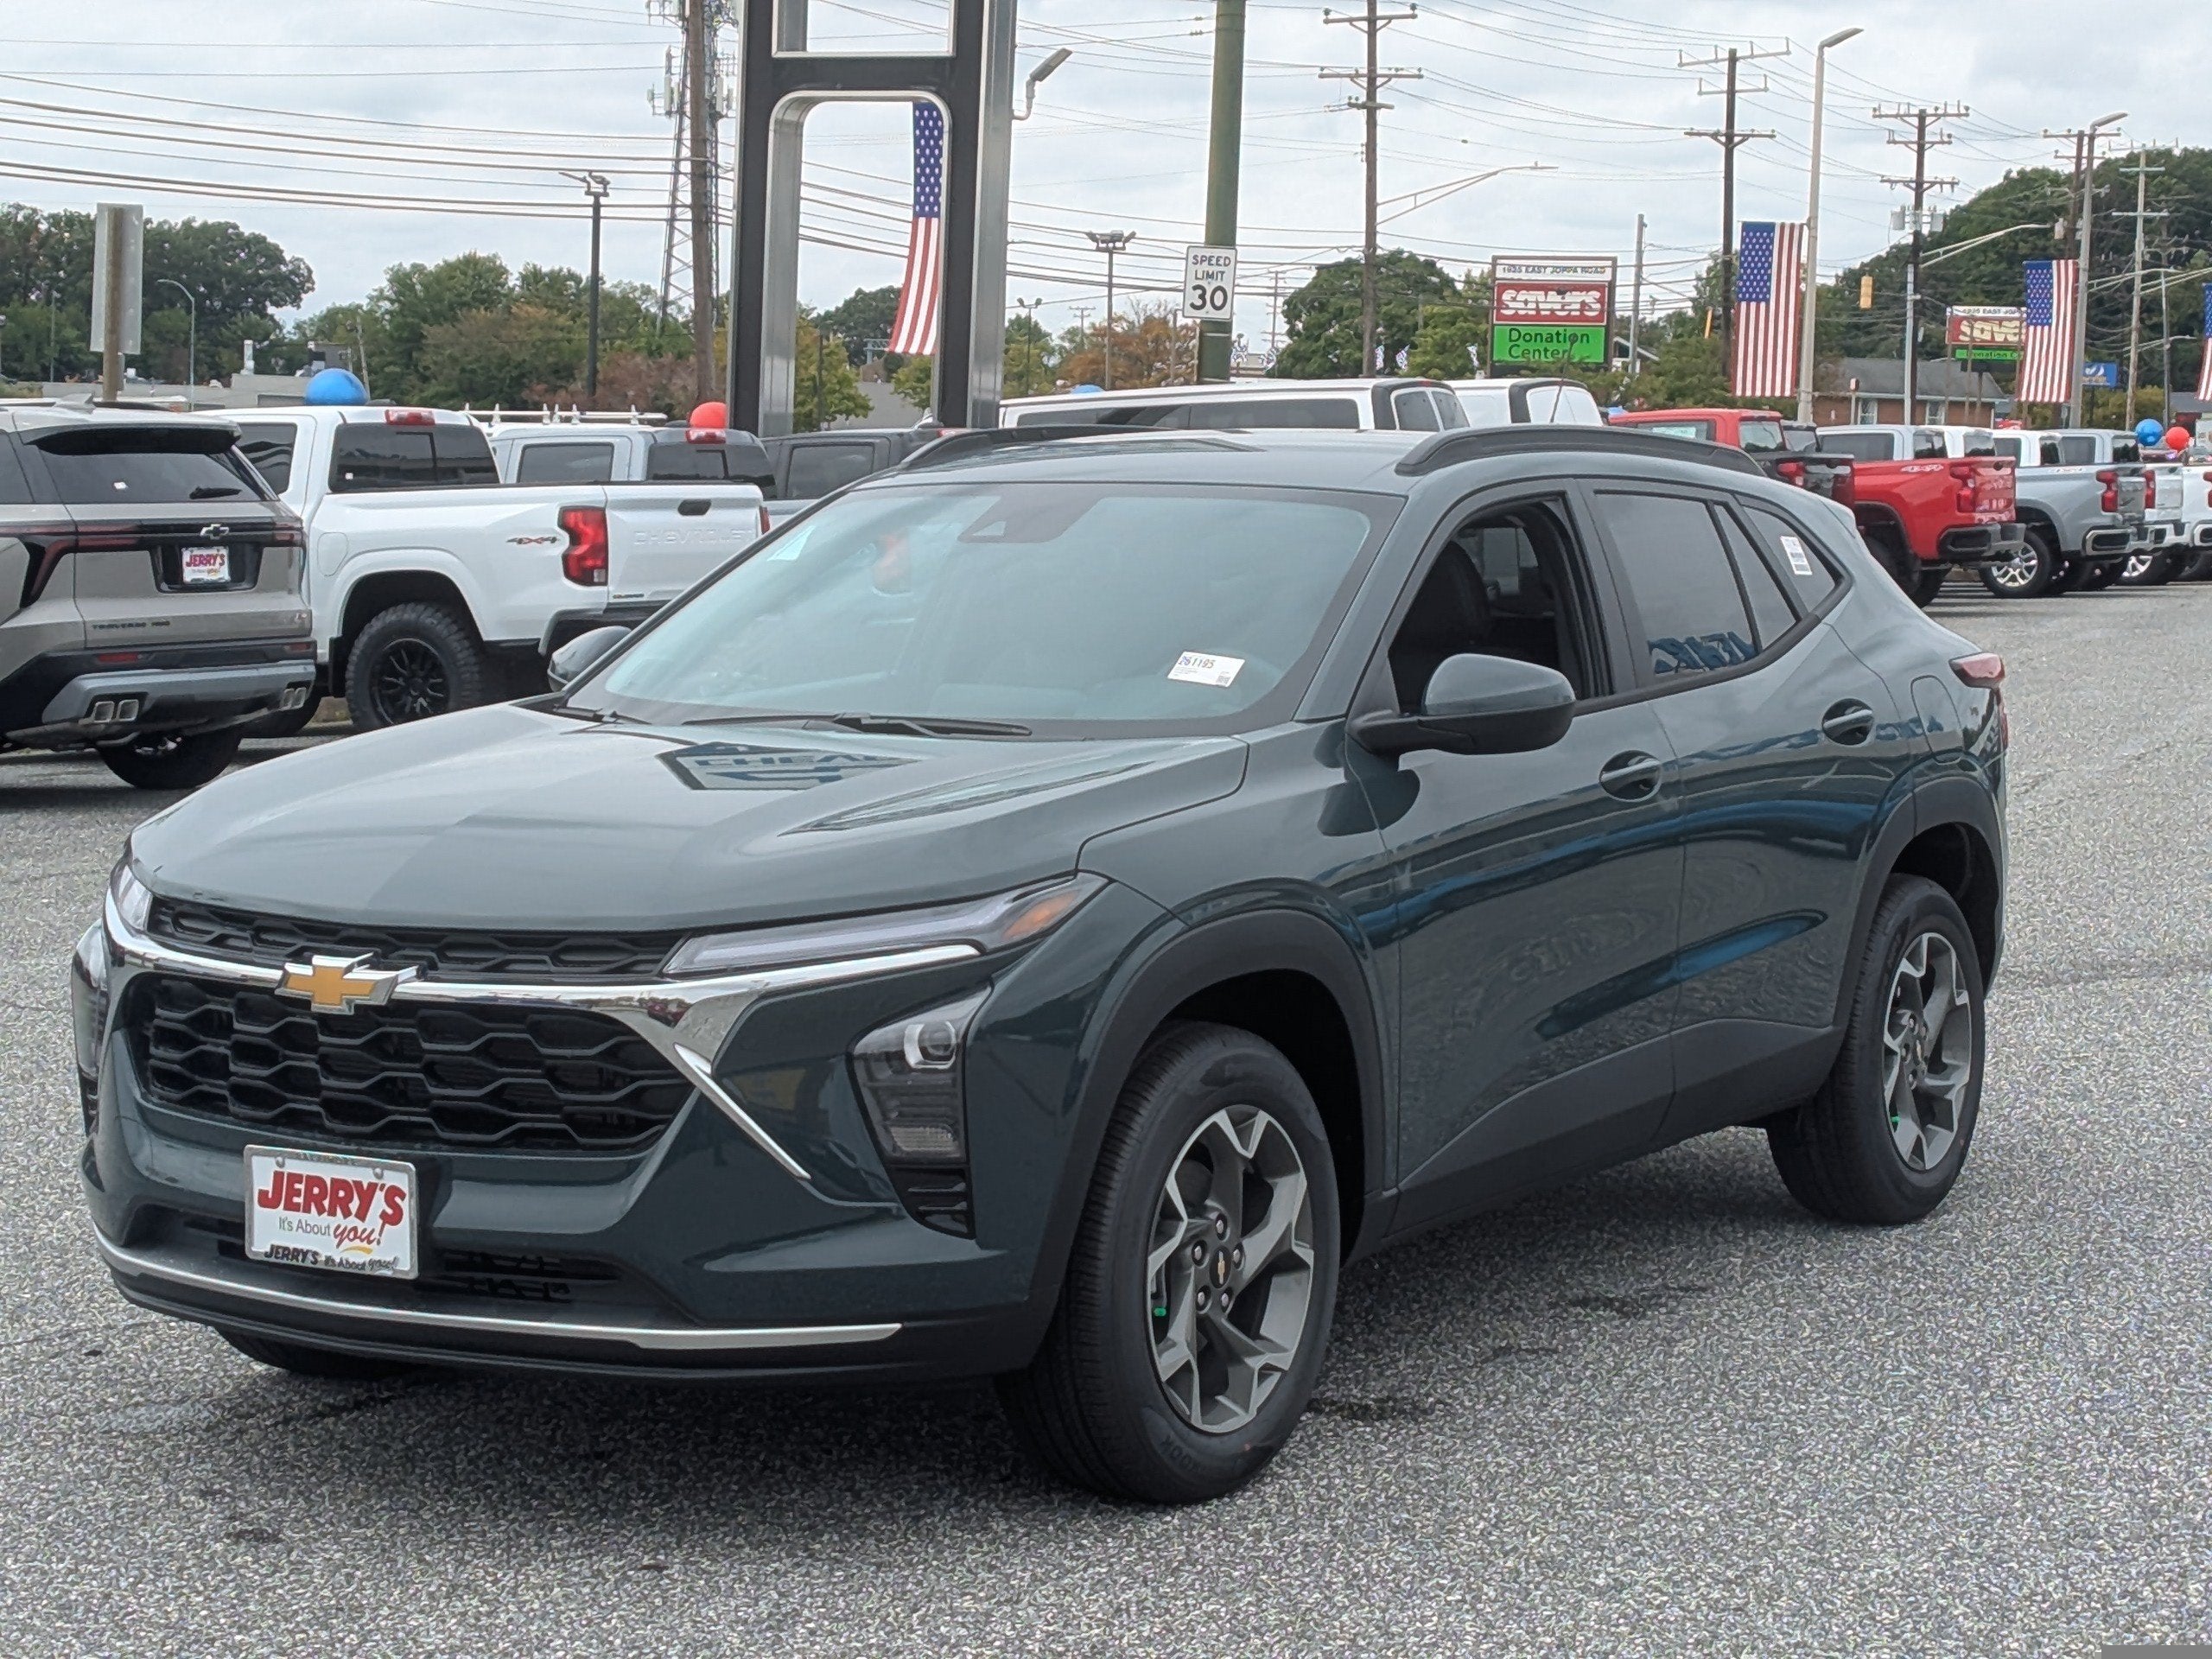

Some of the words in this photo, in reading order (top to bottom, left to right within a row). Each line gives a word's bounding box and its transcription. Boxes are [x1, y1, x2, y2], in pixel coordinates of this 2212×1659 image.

[1192, 254, 1231, 267] SPEED
[1194, 270, 1225, 281] LIMIT
[1525, 265, 1548, 274] EAST
[1189, 283, 1228, 311] 30
[1508, 327, 1590, 344] Donation
[1508, 344, 1571, 359] Center
[257, 1170, 406, 1226] JERRY'S
[278, 1216, 294, 1232] It's
[296, 1220, 332, 1236] About
[333, 1221, 387, 1249] you!
[264, 1243, 320, 1265] JERRY'S
[337, 1256, 366, 1271] About
